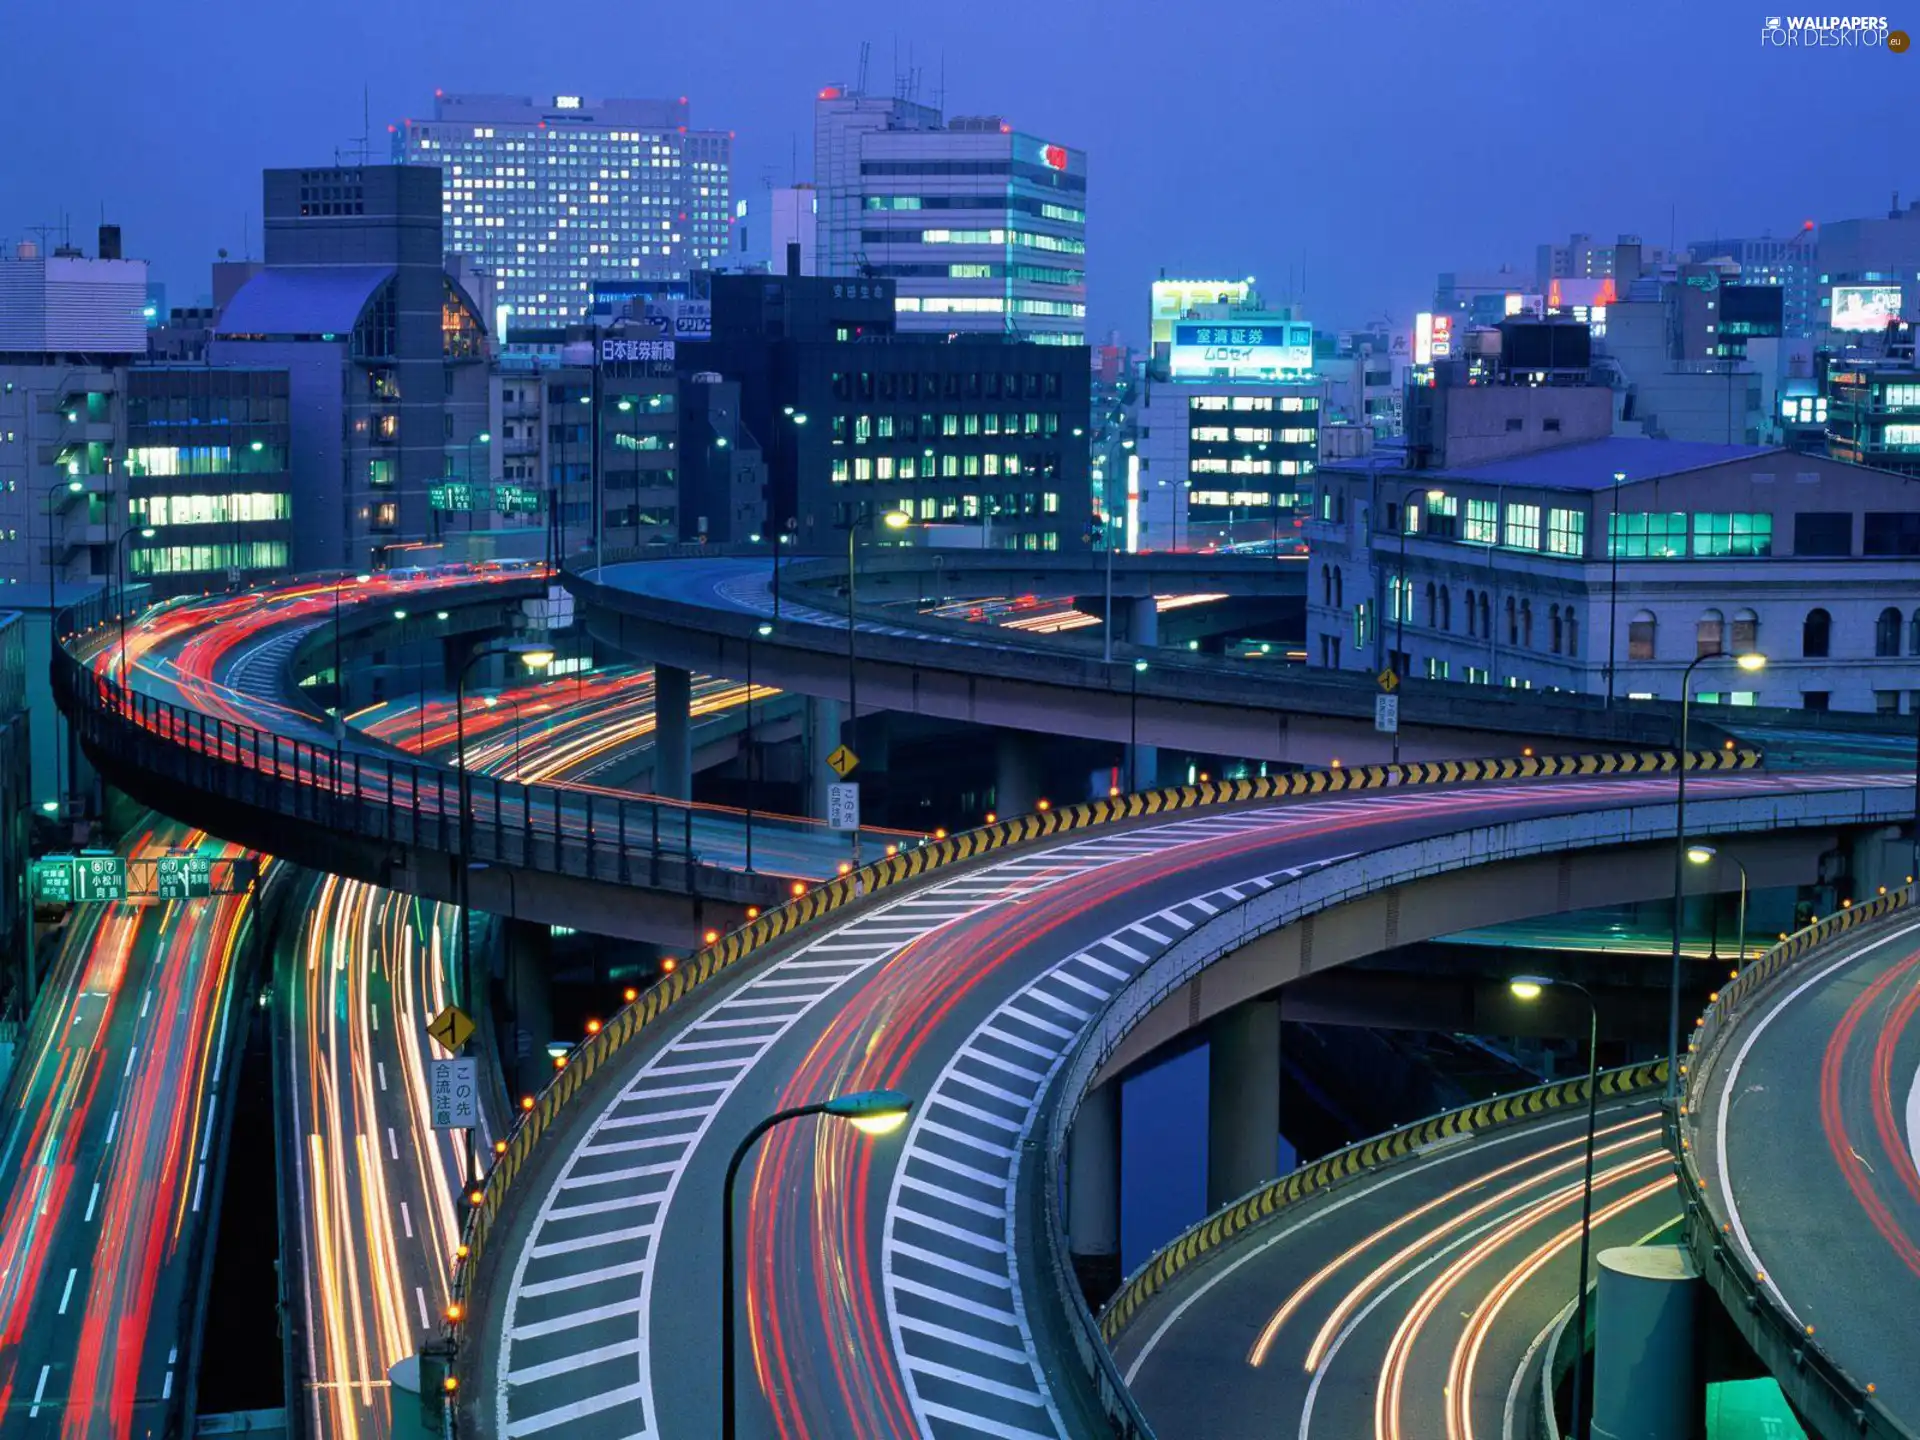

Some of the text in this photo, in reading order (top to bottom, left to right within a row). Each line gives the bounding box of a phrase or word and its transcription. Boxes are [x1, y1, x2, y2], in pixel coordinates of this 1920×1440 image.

[1204, 347, 1254, 360] ムロセイ
[843, 789, 854, 823] この先
[92, 875, 122, 886] 小松川
[435, 1063, 451, 1125] 合流注意
[456, 1066, 472, 1117] この先
